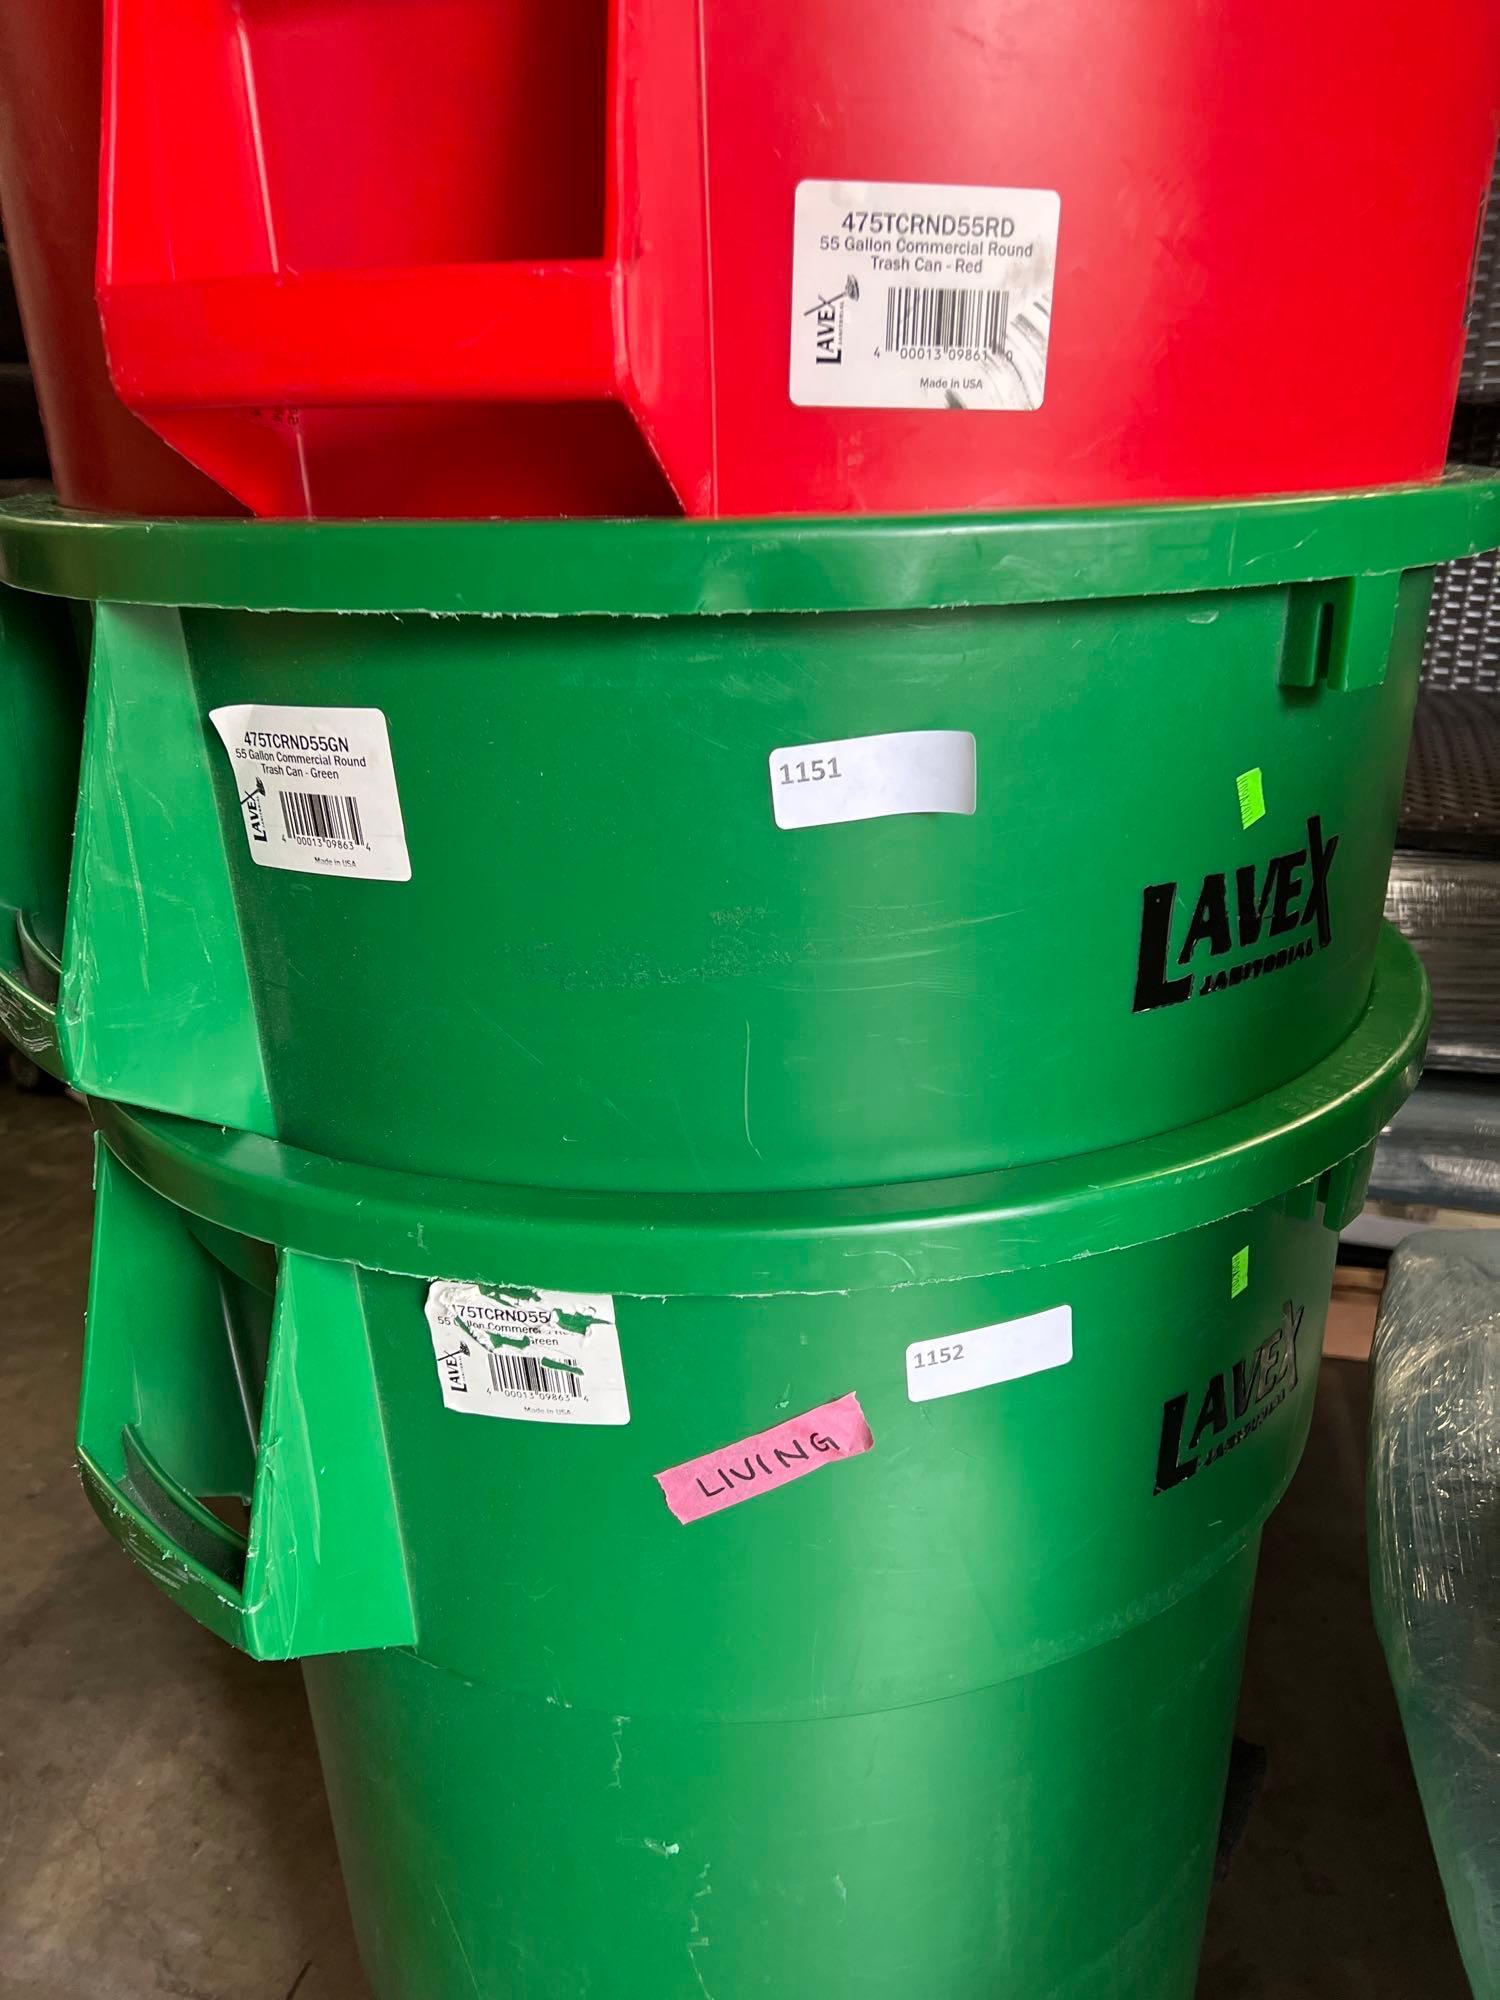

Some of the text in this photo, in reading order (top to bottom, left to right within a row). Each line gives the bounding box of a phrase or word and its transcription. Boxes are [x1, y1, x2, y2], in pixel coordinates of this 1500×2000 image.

[841, 211, 1015, 238] 475TCRND55RD
[820, 236, 1033, 258] 55 Gallon Commercial Round
[871, 256, 910, 272] Trash
[914, 257, 941, 273] Can
[955, 258, 983, 274] Red
[804, 294, 843, 365] LAVEX
[873, 347, 880, 358] 4
[900, 348, 941, 360] 00013
[919, 377, 983, 390] Made in USA
[244, 731, 349, 752] 475TCRND55GN
[235, 748, 366, 767] 55 Gallon Commercial Round
[261, 763, 285, 776] Trash
[285, 764, 304, 777] Can
[310, 766, 339, 779] Green
[779, 756, 842, 785] 1151
[240, 790, 268, 843] LAVEX
[296, 837, 323, 848] 00013
[326, 839, 355, 850] 09863
[365, 843, 371, 851] 4
[314, 856, 333, 864] Made
[343, 860, 357, 868] USA
[1131, 814, 1340, 1014] LAVEX
[437, 1315, 451, 1326] 55
[913, 1343, 965, 1369] 1152
[437, 1350, 468, 1393] LAVEX
[504, 1391, 534, 1400] 00013
[539, 1392, 571, 1402] 09863
[1152, 1299, 1305, 1497] LAVEX
[524, 1406, 545, 1414] Made
[696, 1431, 841, 1498] LIVING
